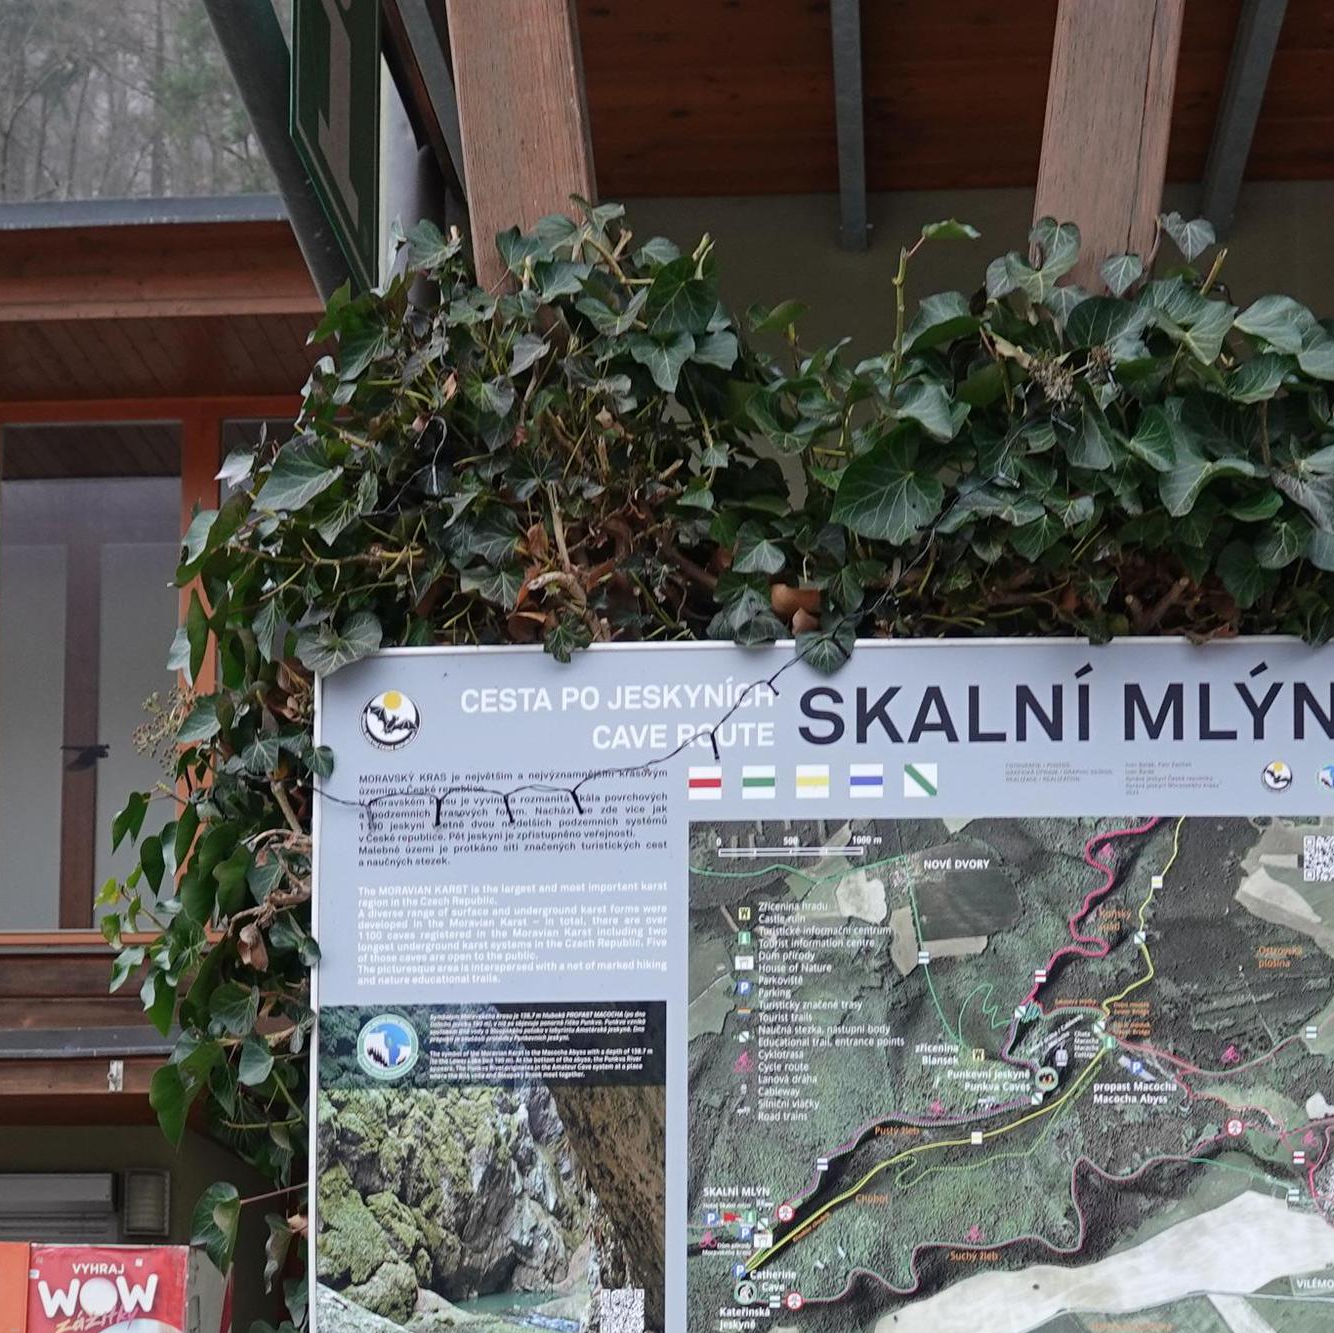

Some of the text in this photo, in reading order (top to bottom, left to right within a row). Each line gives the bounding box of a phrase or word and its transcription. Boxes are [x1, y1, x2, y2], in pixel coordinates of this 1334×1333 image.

[461, 676, 774, 713] CESTA PO JESKYNÍCH
[798, 665, 1093, 745] SKALNÍ
[593, 723, 774, 749] CAVE ROUTE
[783, 837, 798, 845] 500
[852, 835, 872, 845] 1000
[358, 845, 400, 854] Malebné
[439, 844, 449, 854] je
[454, 842, 497, 853] protkáno
[524, 840, 576, 852] značených
[581, 839, 641, 850] turistických
[646, 841, 667, 849] cest
[924, 857, 990, 870] NOVÉ DVORY
[358, 881, 667, 896] The MORAVIAN KARST is the largest and most important karst
[759, 902, 827, 912] Zřícenina hradu
[759, 915, 805, 923] Castle ruin
[759, 926, 891, 936] Turistické informační centrum
[759, 938, 874, 948] Tourist information centre
[783, 951, 815, 962] přírody
[759, 963, 832, 973] House of Nature
[358, 974, 501, 984] and nature educational trails.
[759, 975, 803, 985] Parkoviště
[759, 988, 791, 999] Parking
[803, 1001, 839, 1009] značené
[841, 1001, 863, 1011] trasy
[759, 1013, 812, 1022] Tourist trails
[758, 1025, 791, 1035] Naučná
[827, 1025, 865, 1035] nástupní
[868, 1025, 890, 1035] body
[758, 1037, 809, 1047] Educational
[835, 1038, 874, 1046] entrance
[877, 1037, 904, 1048] points
[758, 1050, 804, 1061] Cyklotrasa
[758, 1062, 782, 1073] Cycle
[758, 1074, 817, 1084] Lanová dráha
[948, 1070, 991, 1079] Punkevní
[965, 1081, 1030, 1091] Punkva Caves
[1094, 1081, 1177, 1095] propast Macocha
[758, 1087, 800, 1098] Cableway
[1094, 1092, 1168, 1105] Macocha Abyss
[758, 1111, 807, 1121] Road trains
[703, 1186, 771, 1197] SKALNÍ MLÝN
[72, 1263, 124, 1275] VYHRAJ
[750, 1269, 796, 1280] Catherine
[762, 1282, 785, 1292] Cave
[38, 1273, 158, 1318] WOW
[720, 1306, 771, 1318] Kateřinská
[720, 1319, 756, 1330] jeskyně
